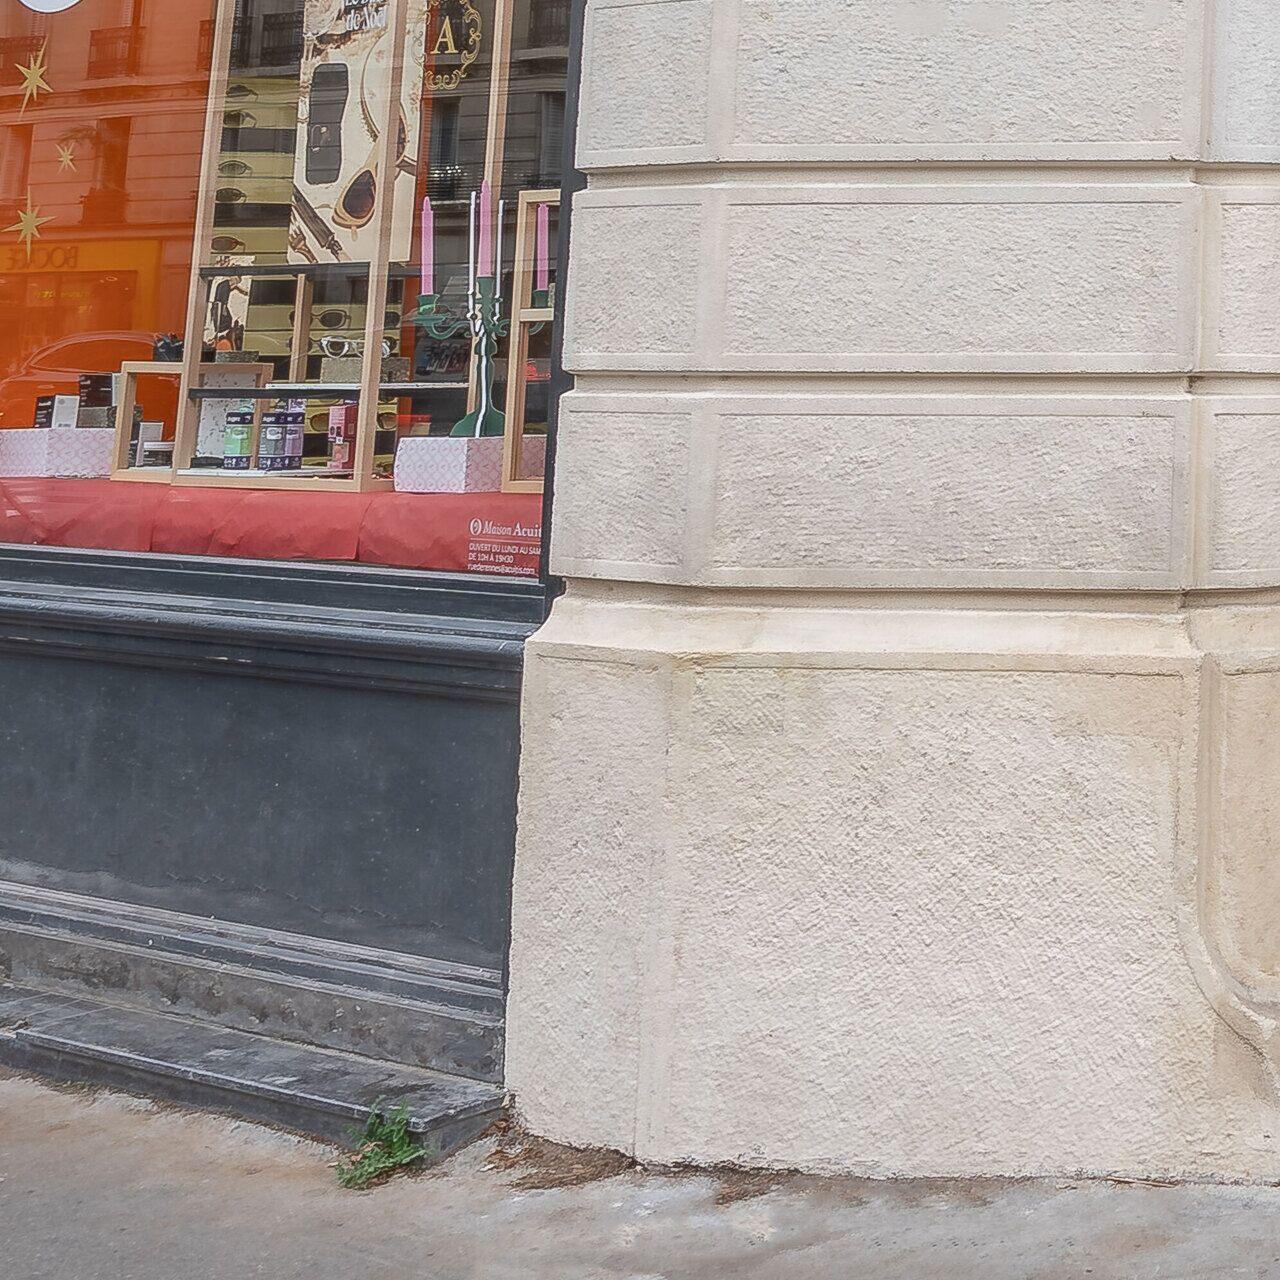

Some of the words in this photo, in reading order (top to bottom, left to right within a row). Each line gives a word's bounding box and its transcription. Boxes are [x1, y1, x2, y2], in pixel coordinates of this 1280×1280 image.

[346, 9, 360, 30] de
[430, 16, 458, 53] A
[482, 520, 512, 535] Maison
[469, 543, 490, 551] OUVERT
[492, 543, 500, 552] DU
[519, 546, 528, 554] AU
[468, 552, 476, 561] DE
